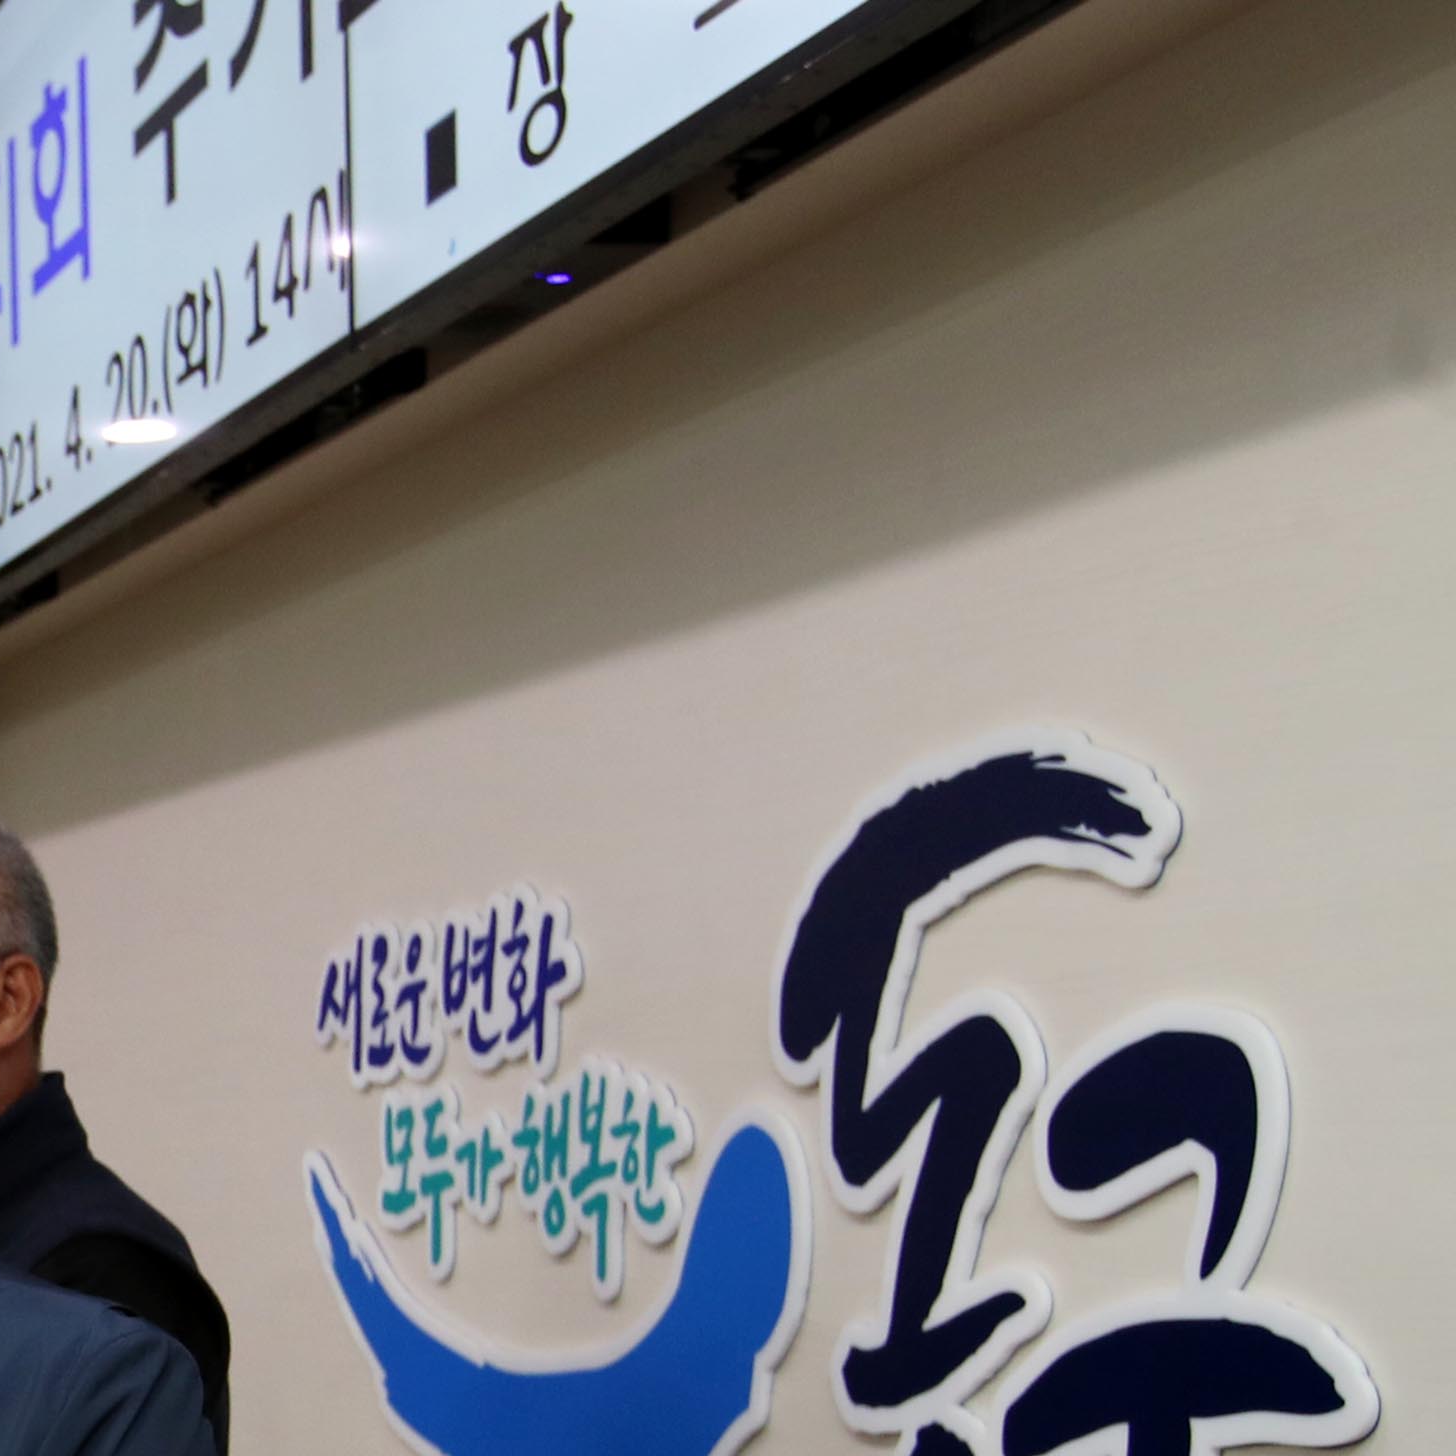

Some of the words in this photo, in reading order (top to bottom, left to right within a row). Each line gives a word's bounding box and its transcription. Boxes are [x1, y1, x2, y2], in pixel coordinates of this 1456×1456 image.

[318, 933, 431, 1073] 새로운
[442, 899, 568, 1063] 변화
[382, 1098, 503, 1265] 모두가
[513, 1070, 676, 1282] 행복한
